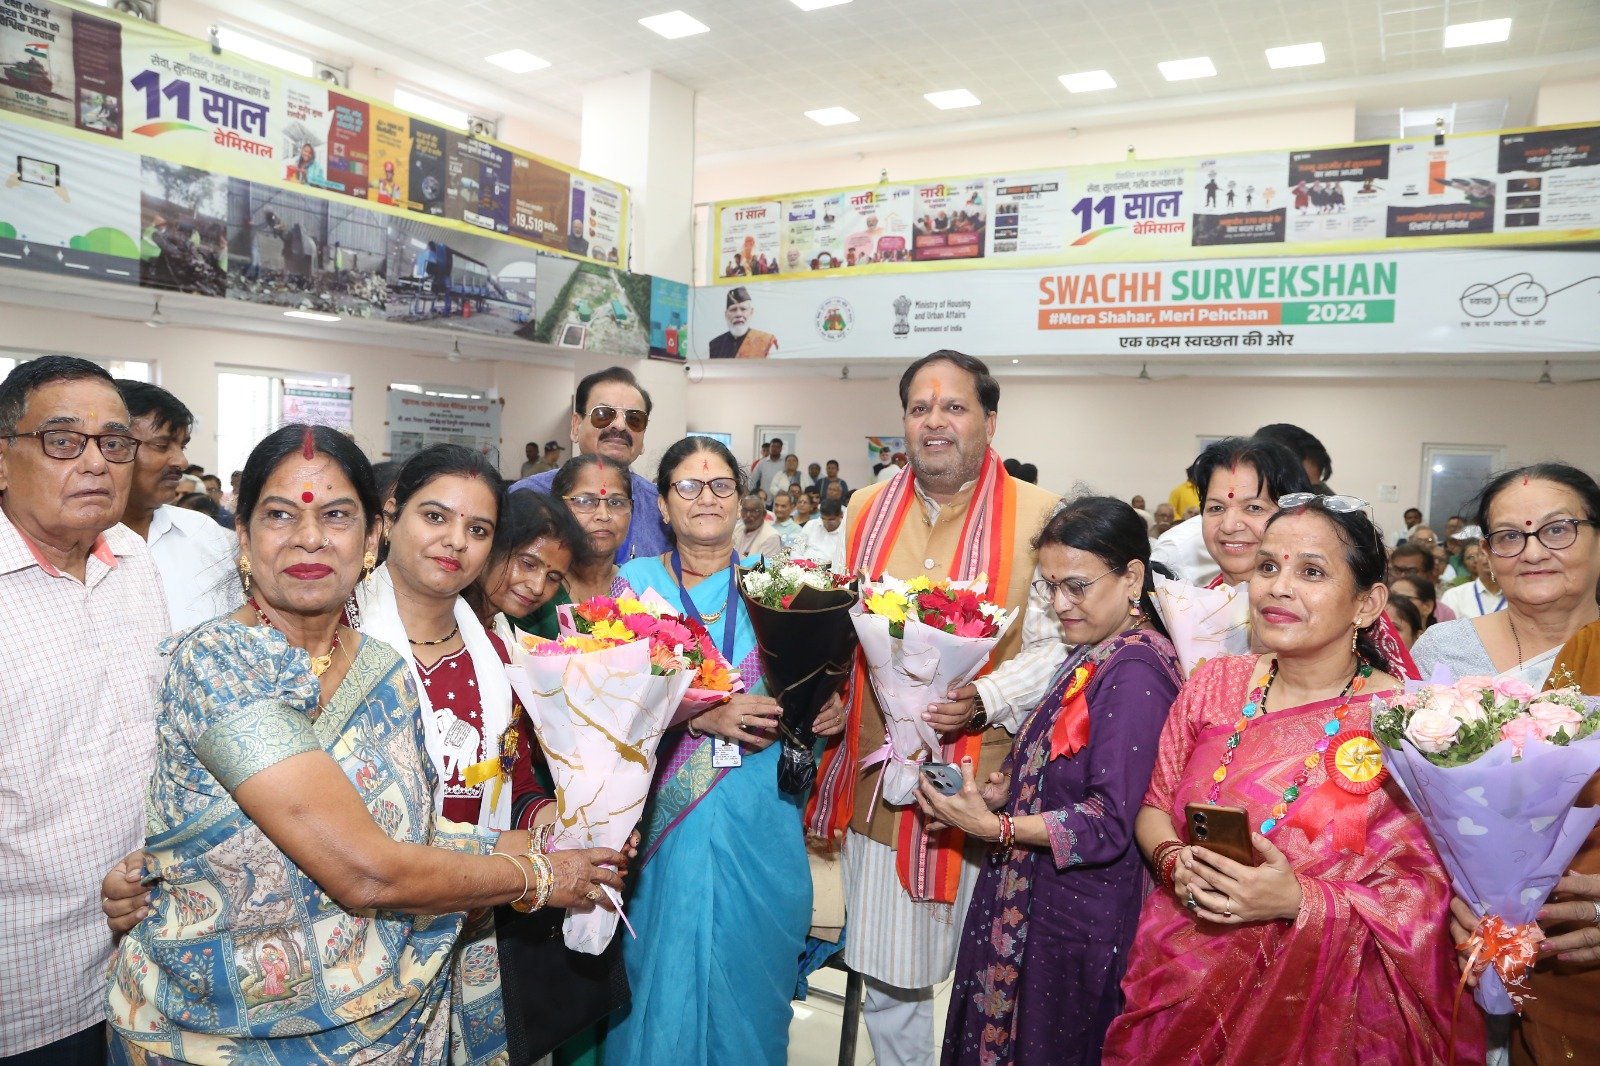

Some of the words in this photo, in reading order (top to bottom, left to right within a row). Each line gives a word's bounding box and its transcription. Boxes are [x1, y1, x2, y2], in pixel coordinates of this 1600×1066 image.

[41, 8, 51, 19] में
[27, 25, 55, 42] पहचान
[173, 60, 209, 83] सुशासन,
[211, 73, 231, 89] गरीब
[232, 81, 261, 98] कल्याण
[130, 69, 190, 121] 11
[199, 86, 270, 138] साल
[213, 127, 273, 158] बेमिसाल
[851, 191, 873, 206] नारी
[920, 184, 945, 198] नारी
[745, 208, 767, 220] साल
[1071, 196, 1115, 233] 11
[1123, 191, 1182, 220] साल
[1132, 220, 1185, 235] बेमिसाल
[1039, 271, 1162, 306] SWACHH
[1171, 261, 1398, 301] SURVEKSHAN
[915, 300, 938, 310] Ministry
[947, 300, 971, 310] Housing
[1307, 303, 1367, 322] 2024
[915, 311, 926, 320] and
[927, 311, 944, 319] Urban
[946, 311, 966, 319] Affairs
[1049, 310, 1096, 325] #Mera
[1099, 308, 1156, 325] Shahar,
[1159, 307, 1193, 323] Meri
[1198, 306, 1269, 321] Pehchan
[914, 325, 942, 333] Government
[1120, 335, 1142, 348] एक
[1146, 335, 1180, 349] कदम
[1184, 334, 1238, 348] स्वच्छता
[1242, 331, 1262, 347] की
[1266, 330, 1294, 347] ओर
